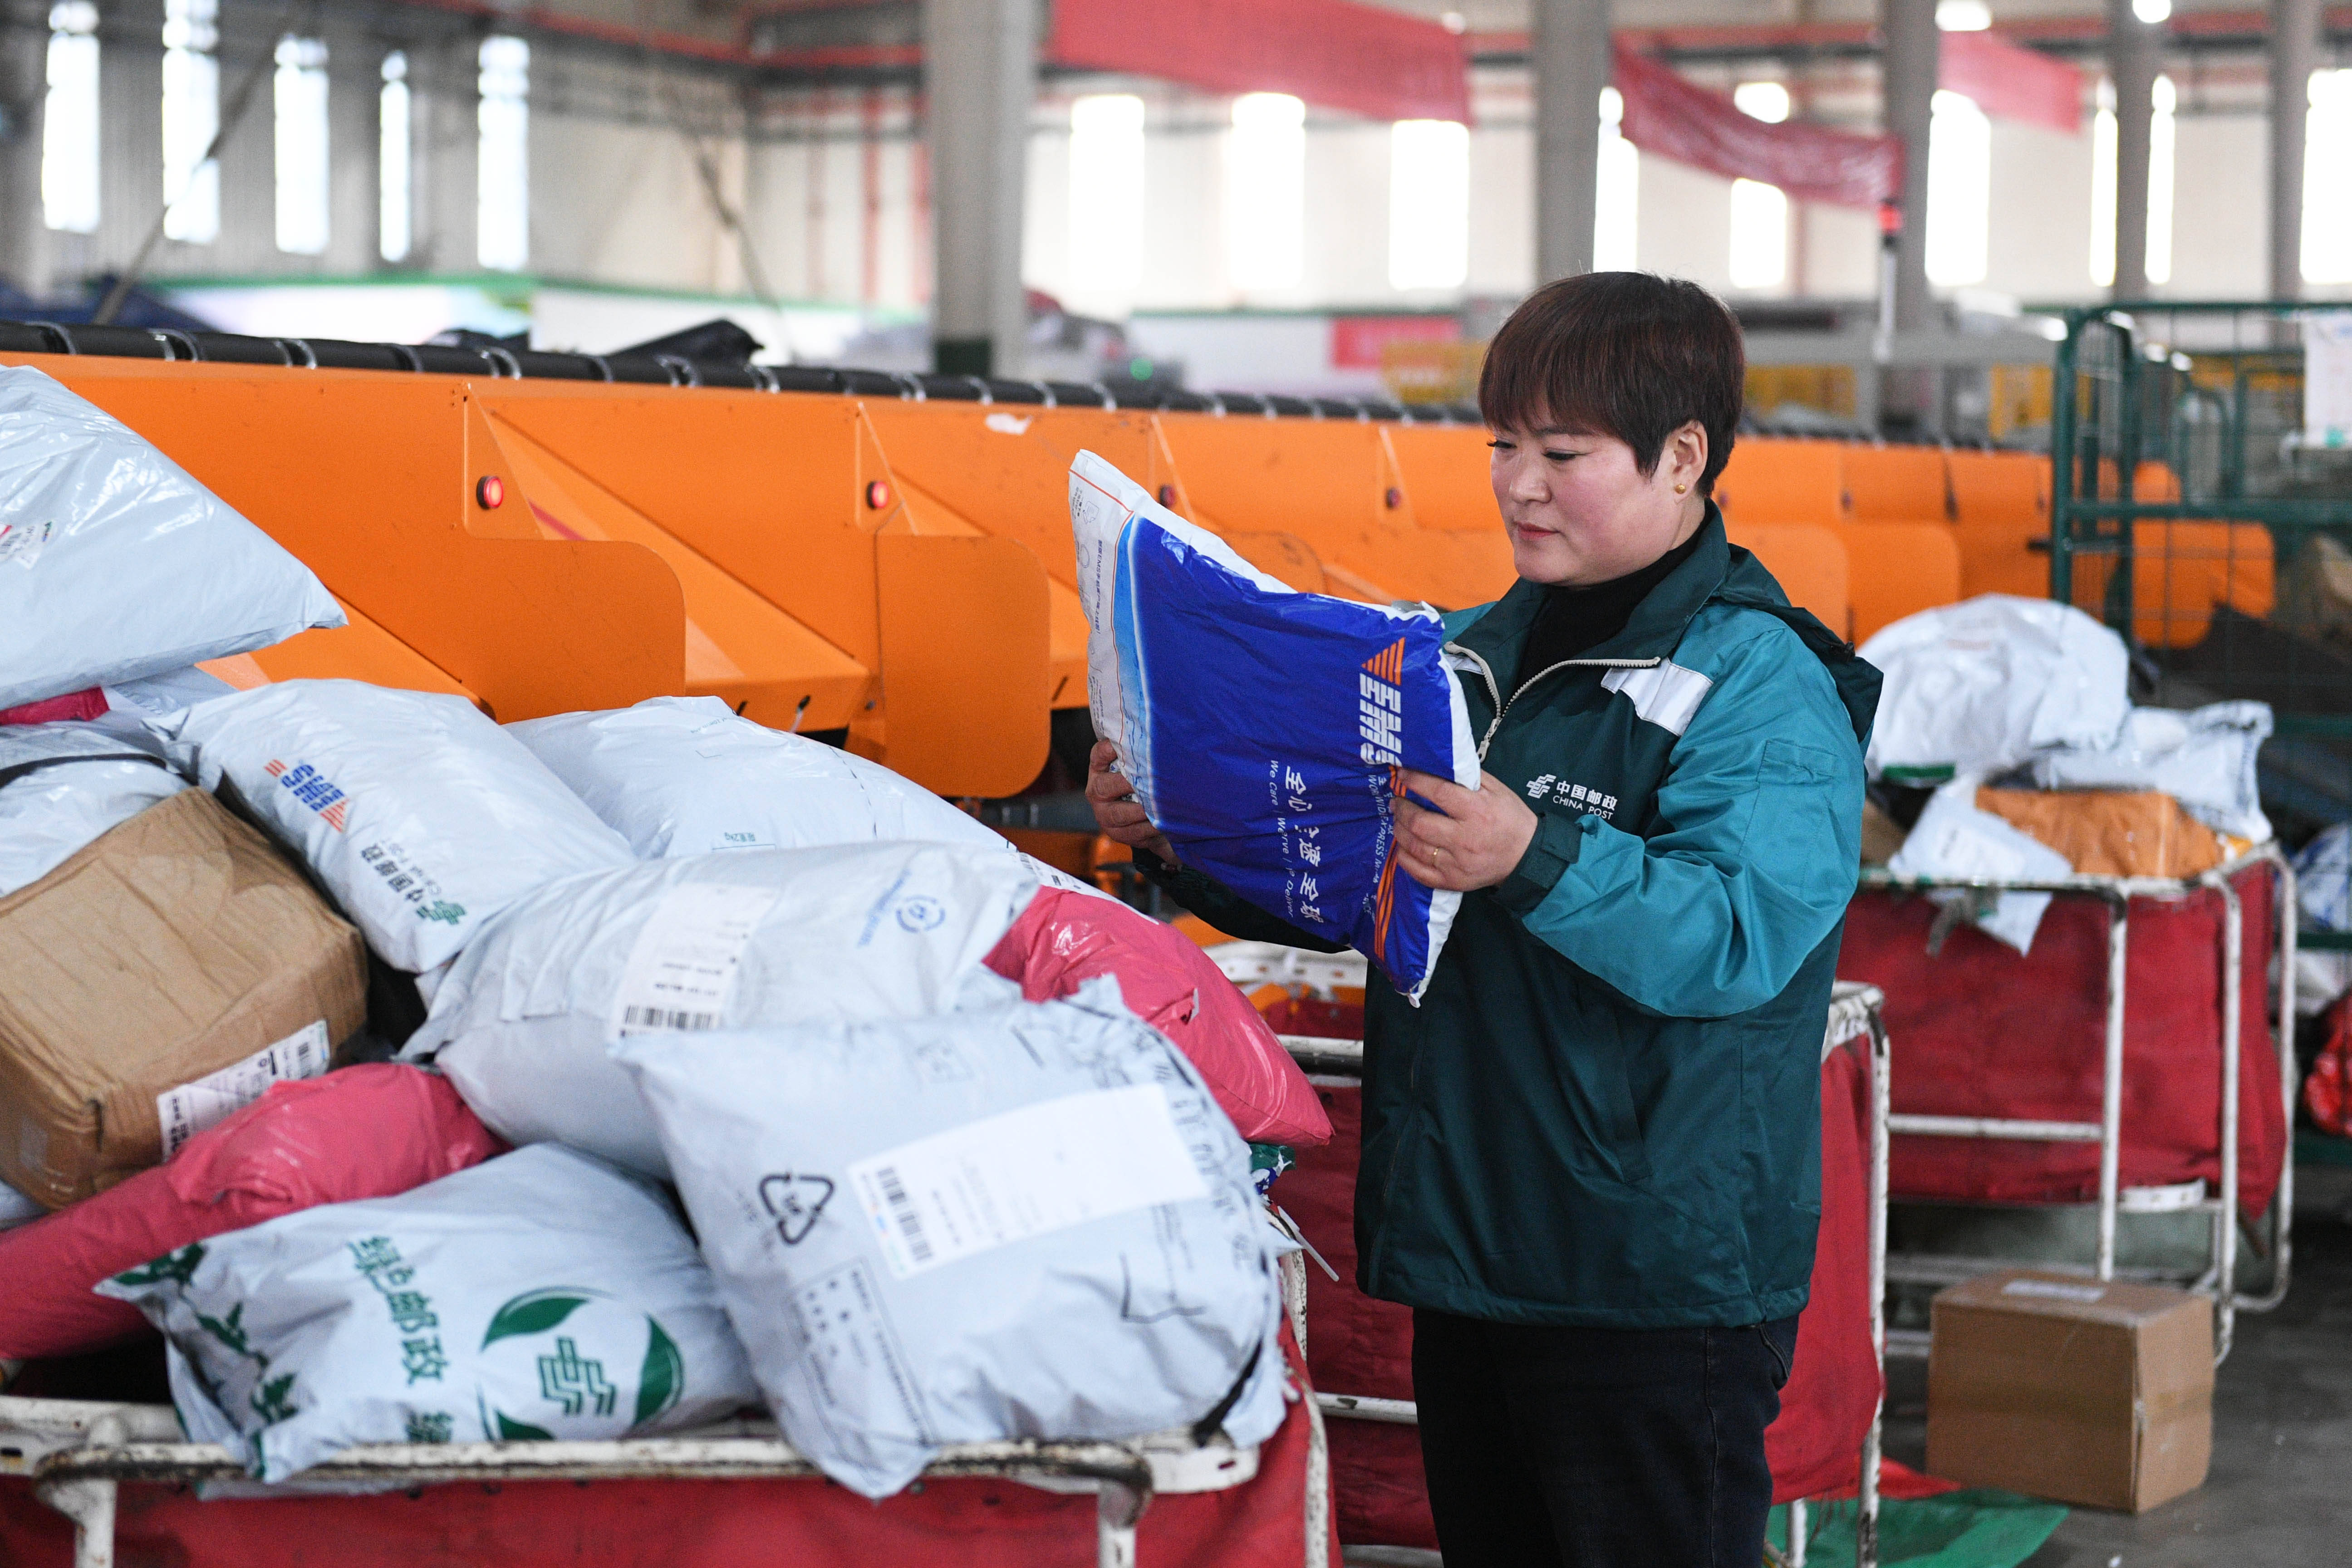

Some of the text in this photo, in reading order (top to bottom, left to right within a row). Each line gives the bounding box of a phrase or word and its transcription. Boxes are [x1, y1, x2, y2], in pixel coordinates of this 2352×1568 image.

[1360, 673, 1402, 767] EMS
[280, 764, 345, 812] EMS
[1270, 760, 1278, 778] We
[1269, 782, 1278, 806] Care
[1552, 795, 1613, 820] CHINA POST
[1556, 780, 1618, 811] 中国邮政
[361, 843, 424, 902] 中国邮政
[1285, 880, 1293, 918] Deliver
[347, 1235, 450, 1387] 绿色邮政
